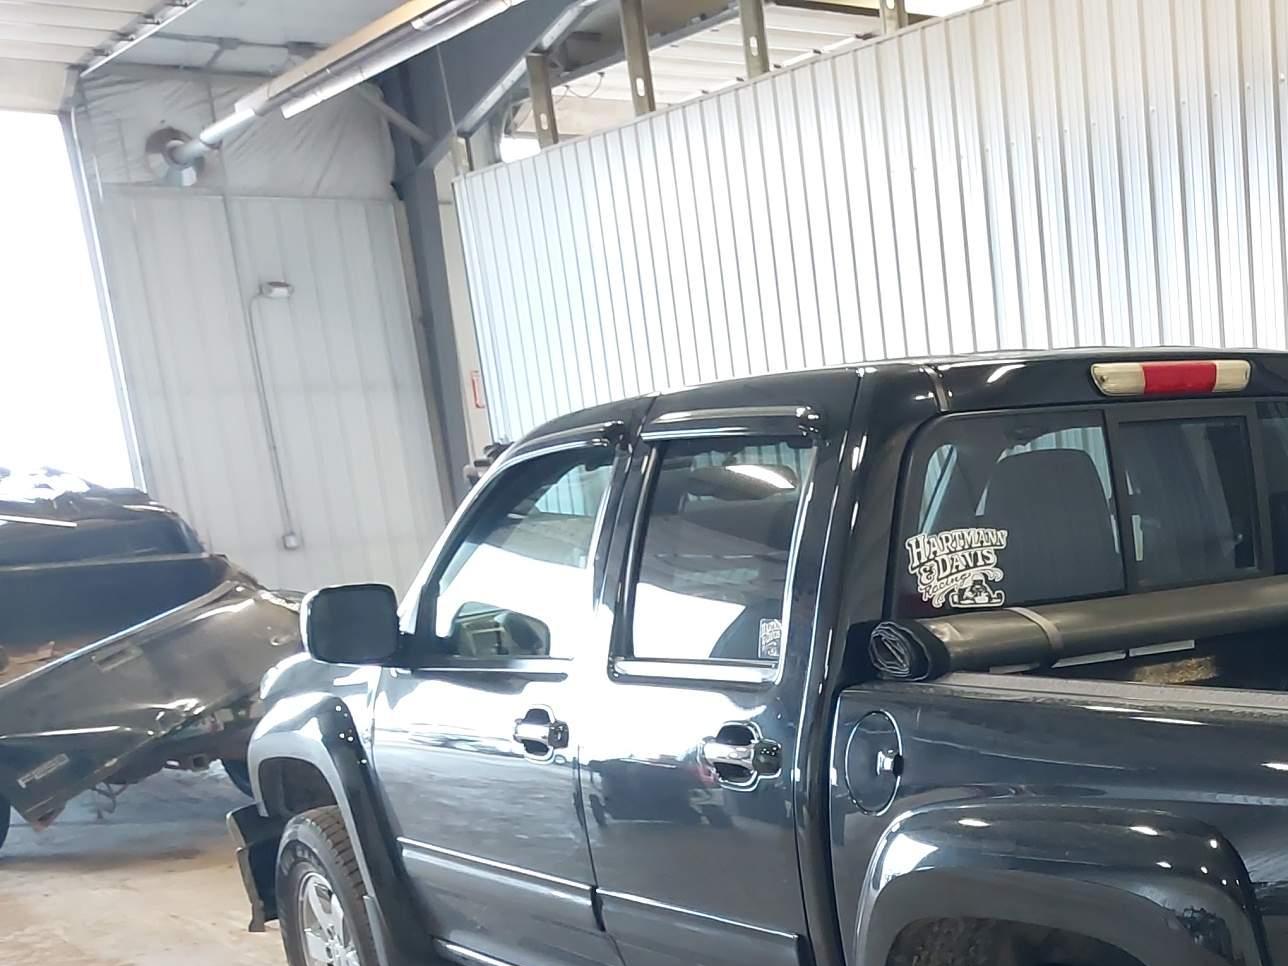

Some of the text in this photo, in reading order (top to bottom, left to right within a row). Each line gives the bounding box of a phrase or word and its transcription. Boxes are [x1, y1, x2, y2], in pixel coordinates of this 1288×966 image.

[907, 529, 1008, 567] HARTMANN
[920, 549, 996, 586] & DAVIS
[921, 572, 971, 600] Racing
